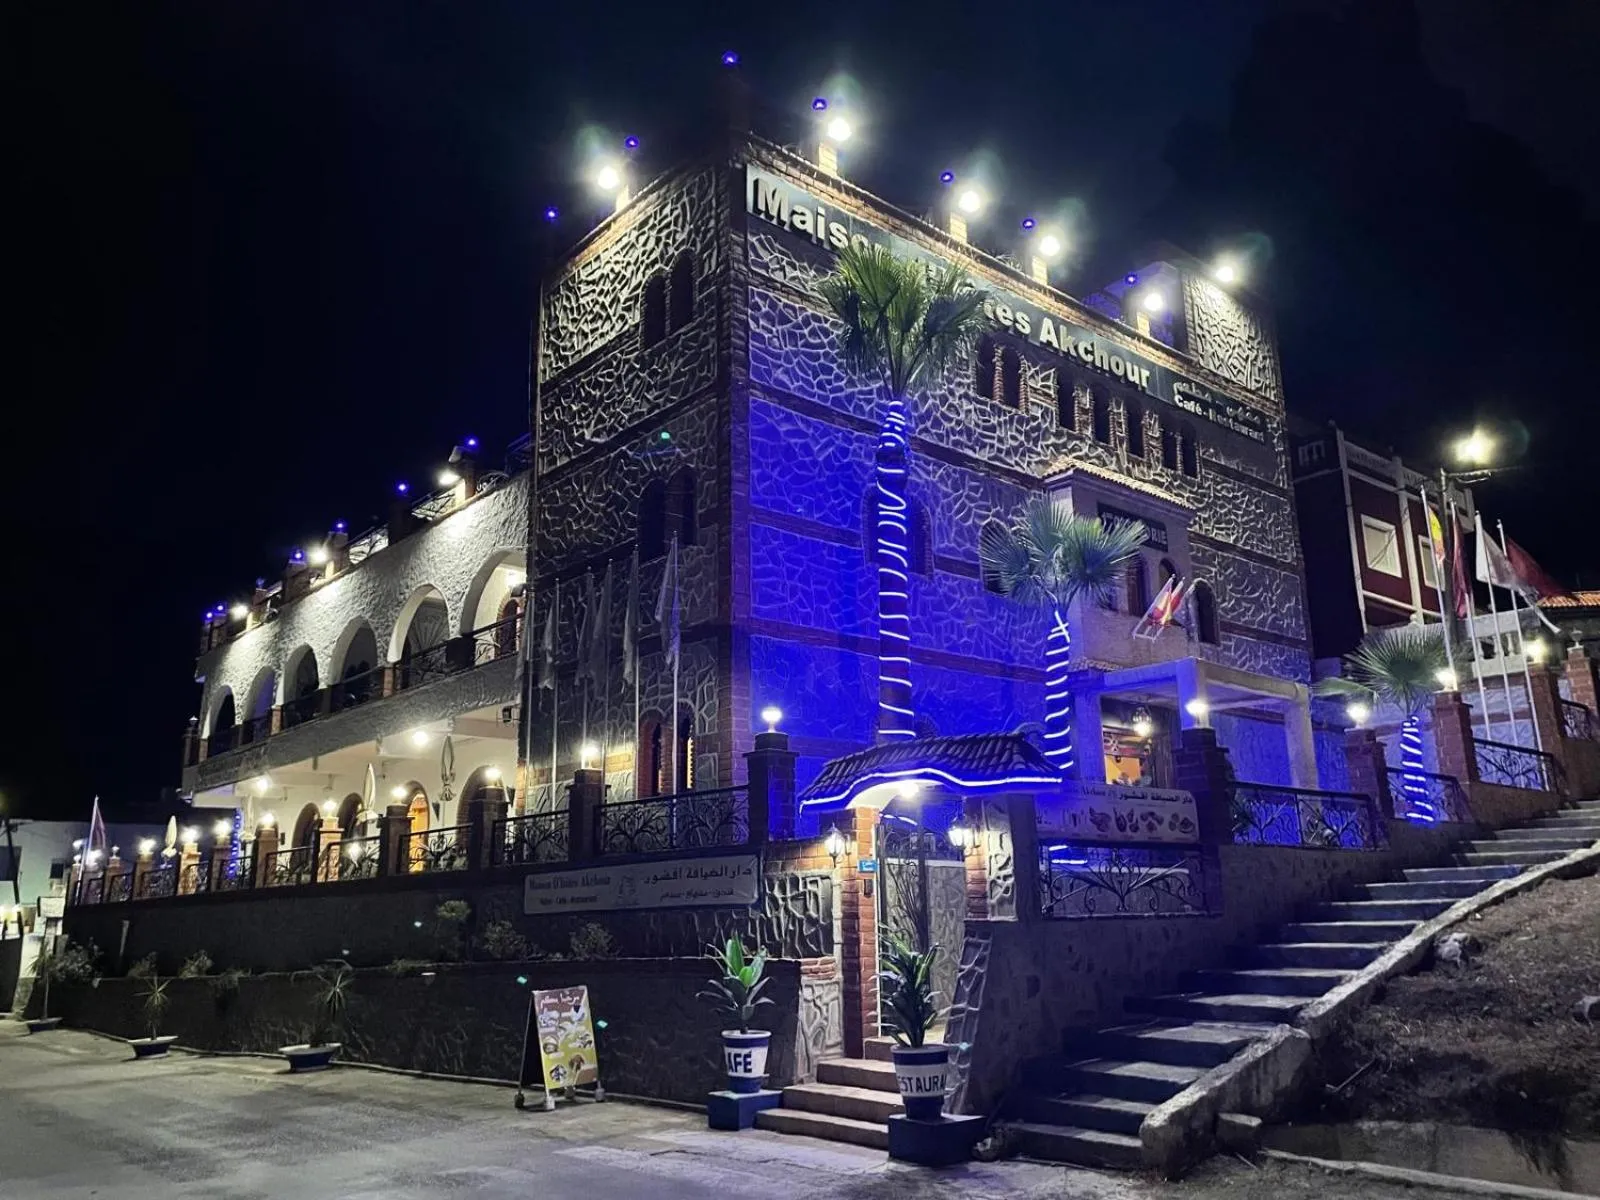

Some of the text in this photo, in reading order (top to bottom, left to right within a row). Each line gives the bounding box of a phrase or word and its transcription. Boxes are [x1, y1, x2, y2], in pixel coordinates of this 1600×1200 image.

[755, 178, 878, 252] Maiso
[1040, 318, 1150, 389] Akchour
[729, 864, 752, 880] دار
